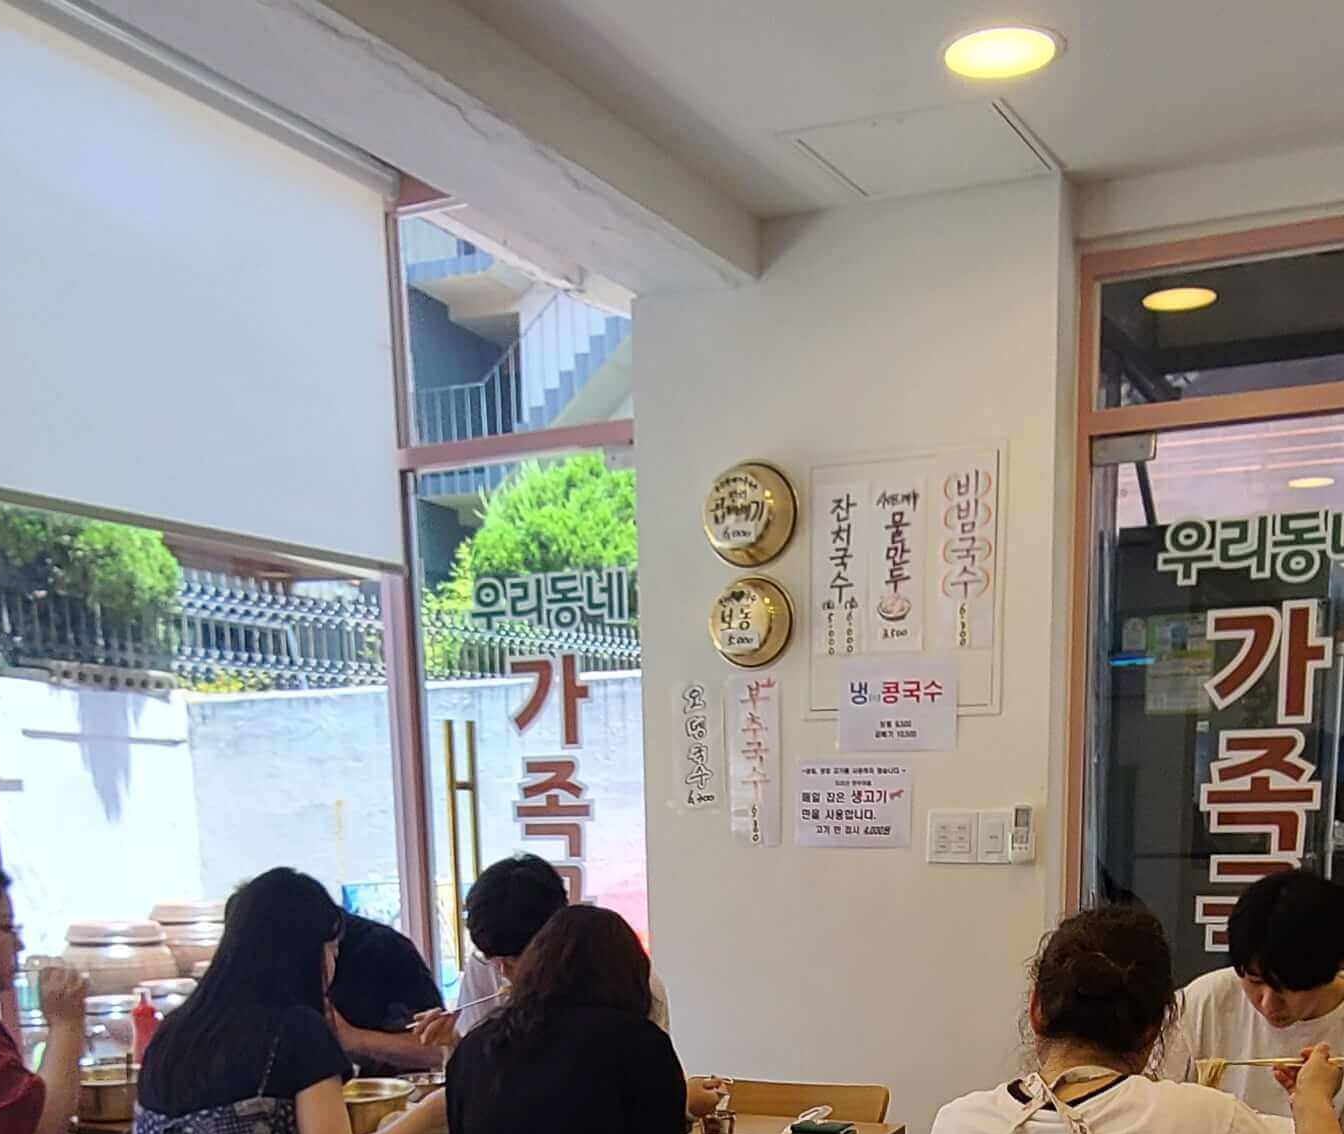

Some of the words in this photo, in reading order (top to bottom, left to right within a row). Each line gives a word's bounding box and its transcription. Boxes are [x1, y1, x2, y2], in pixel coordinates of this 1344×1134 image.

[830, 493, 857, 604] 잔치국수
[884, 511, 911, 592] 물만두
[951, 469, 983, 600] 비빔국수
[470, 567, 629, 630] 우리동네
[881, 680, 943, 704] 콩국수
[825, 809, 877, 820] 사용합니다.
[852, 789, 887, 803] 생고기
